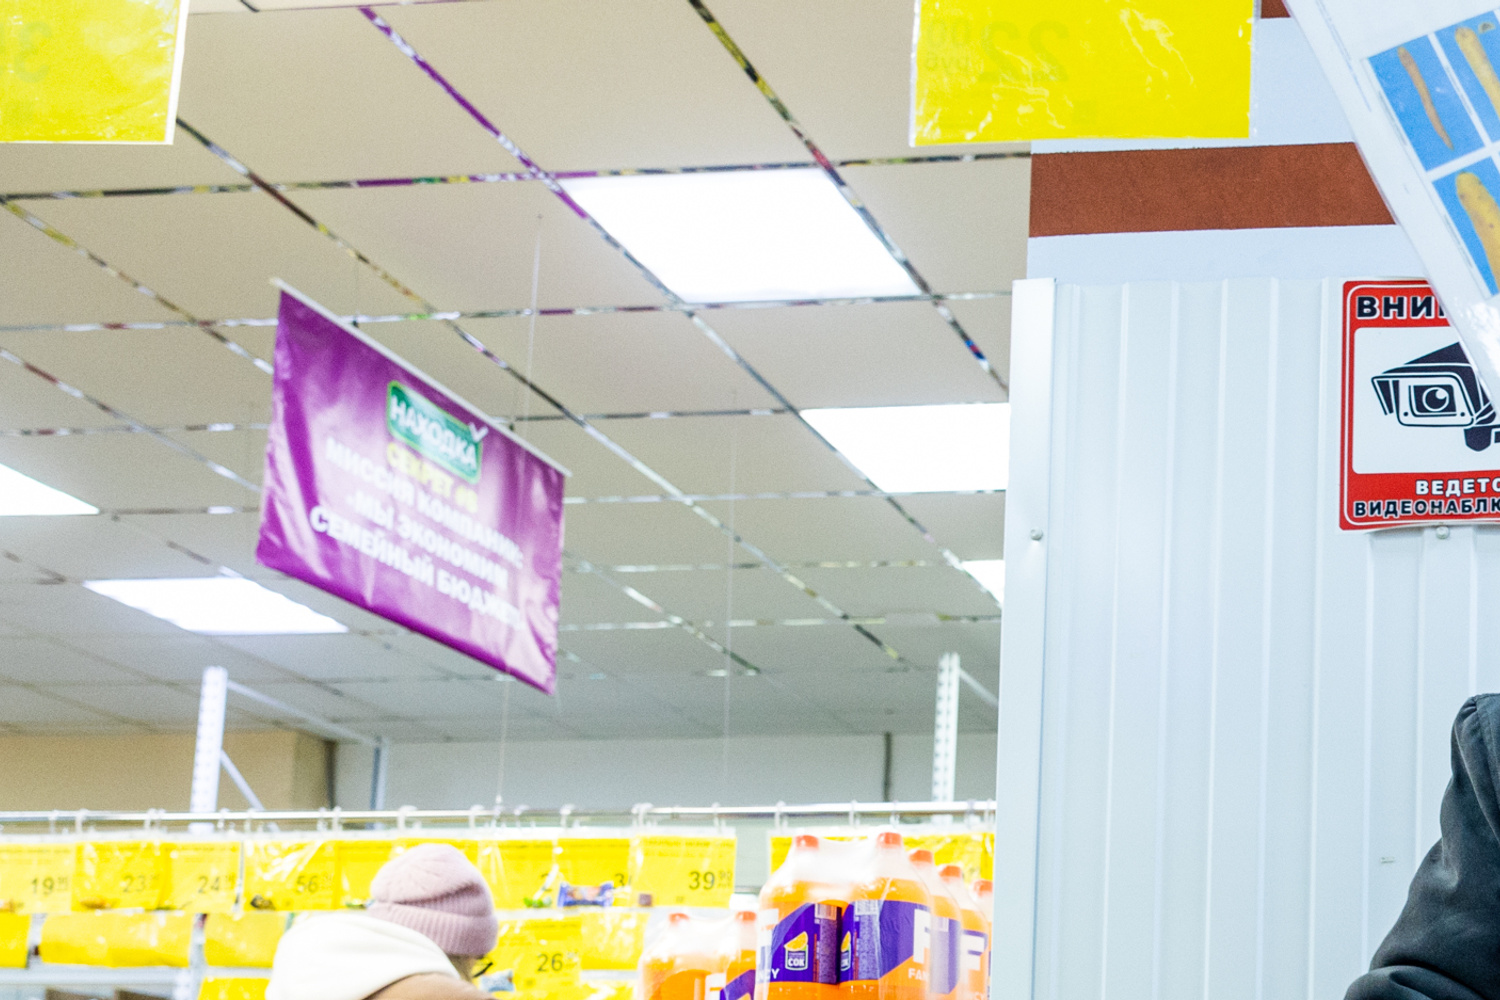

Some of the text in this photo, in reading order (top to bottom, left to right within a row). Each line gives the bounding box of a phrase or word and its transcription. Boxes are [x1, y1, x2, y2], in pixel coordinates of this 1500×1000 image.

[1356, 296, 1446, 320] ВНИ
[390, 396, 478, 470] НАХОДКА
[325, 436, 415, 507] МИССИЯ
[386, 443, 453, 498] СЕКРЕТ
[397, 515, 509, 591] ЭКОНОМИМ
[689, 871, 715, 890] 39
[536, 953, 564, 972] 26
